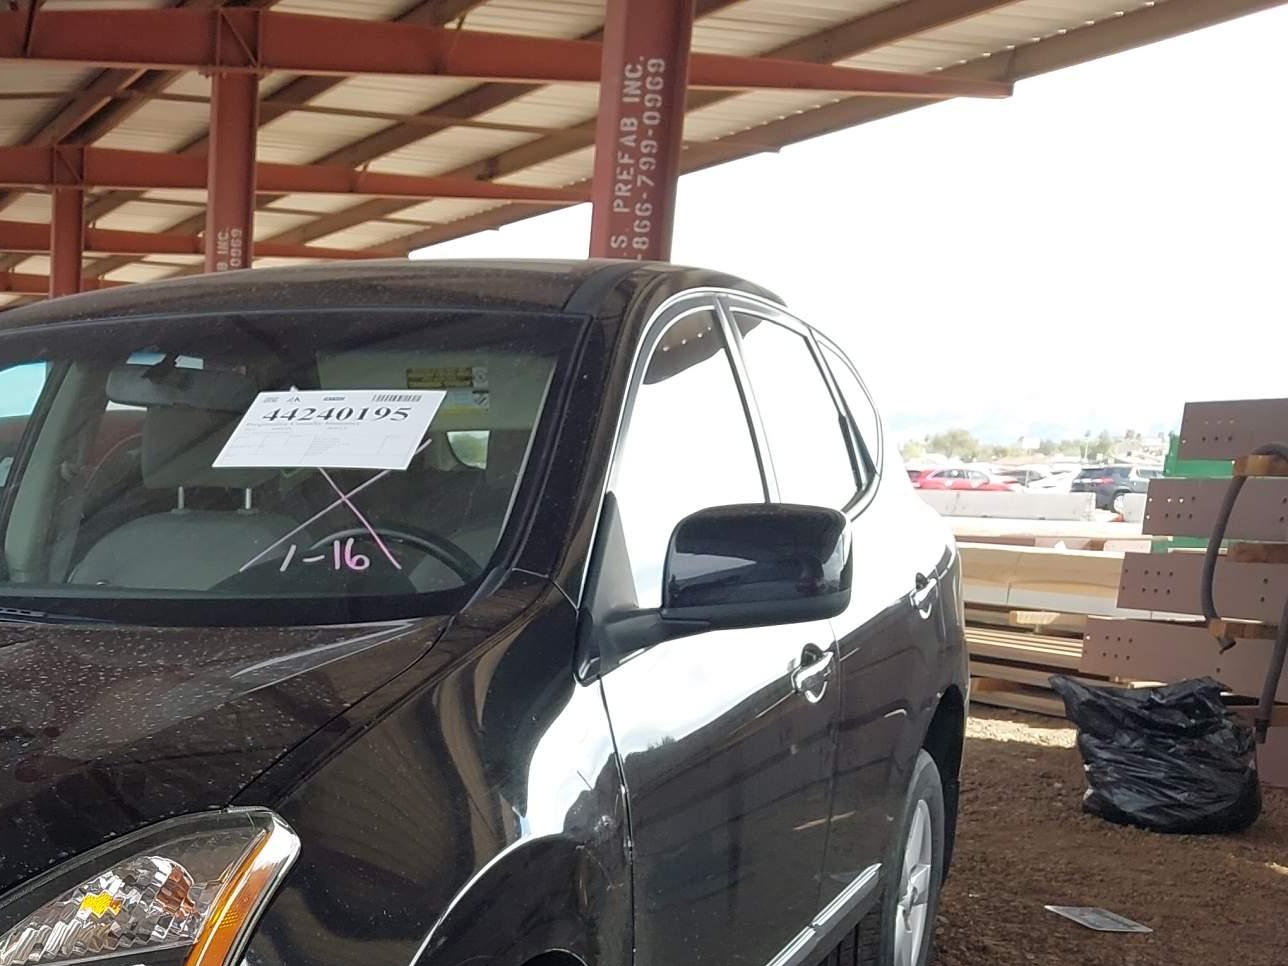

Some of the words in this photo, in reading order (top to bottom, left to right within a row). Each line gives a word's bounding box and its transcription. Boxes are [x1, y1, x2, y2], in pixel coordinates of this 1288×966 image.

[613, 116, 639, 213] PREFAB
[261, 406, 412, 422] 44240195
[280, 537, 371, 572] 1-16
